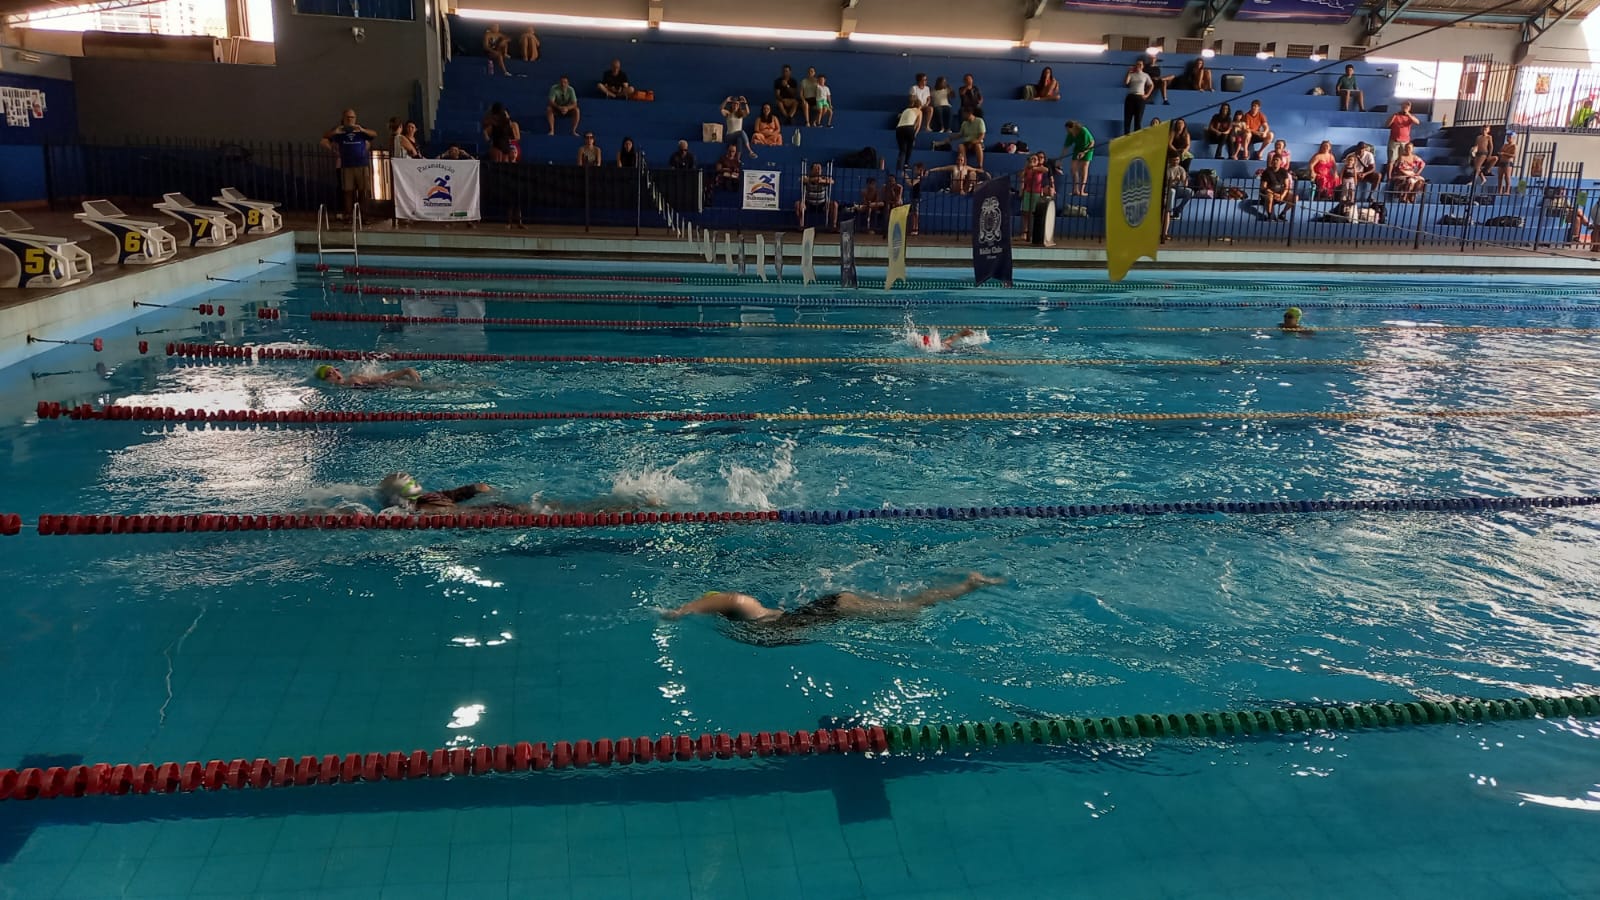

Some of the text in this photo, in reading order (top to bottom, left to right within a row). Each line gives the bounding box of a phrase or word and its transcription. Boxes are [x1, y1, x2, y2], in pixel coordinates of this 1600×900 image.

[247, 208, 260, 225] 8
[194, 218, 209, 237] 7
[124, 231, 141, 253] 6
[24, 248, 45, 274] 5
